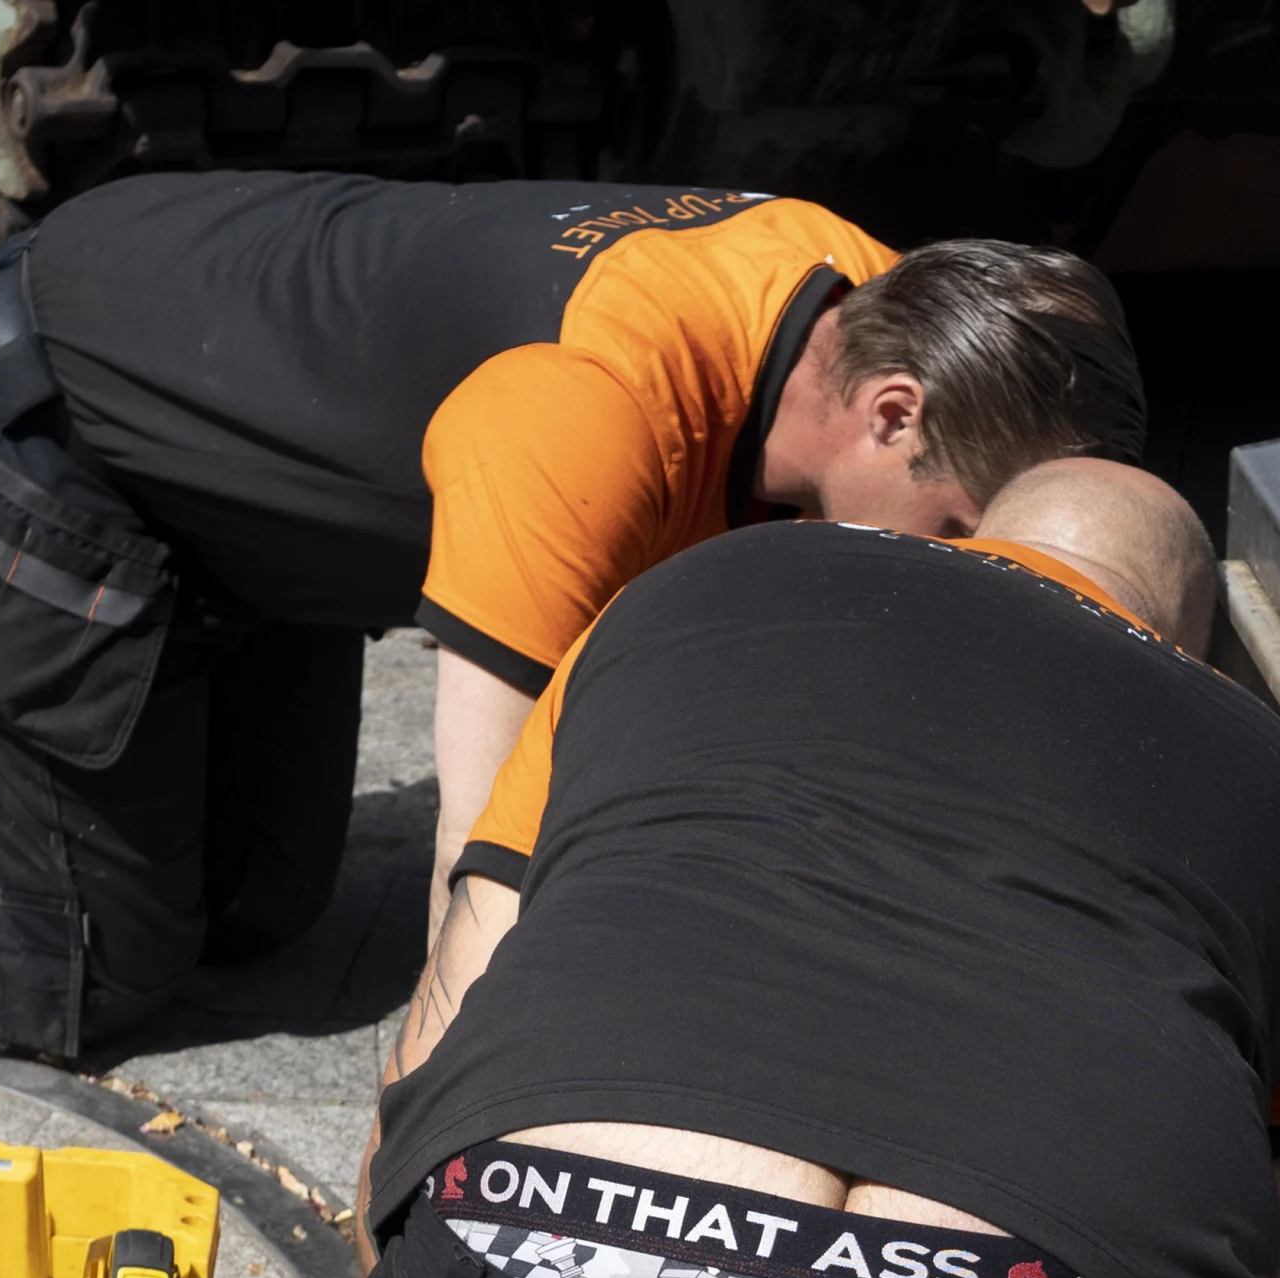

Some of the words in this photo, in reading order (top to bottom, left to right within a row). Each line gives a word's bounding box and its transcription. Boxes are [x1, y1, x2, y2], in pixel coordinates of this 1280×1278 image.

[550, 205, 669, 260] TOILET
[479, 1159, 572, 1215] ON
[587, 1176, 799, 1260] THAT
